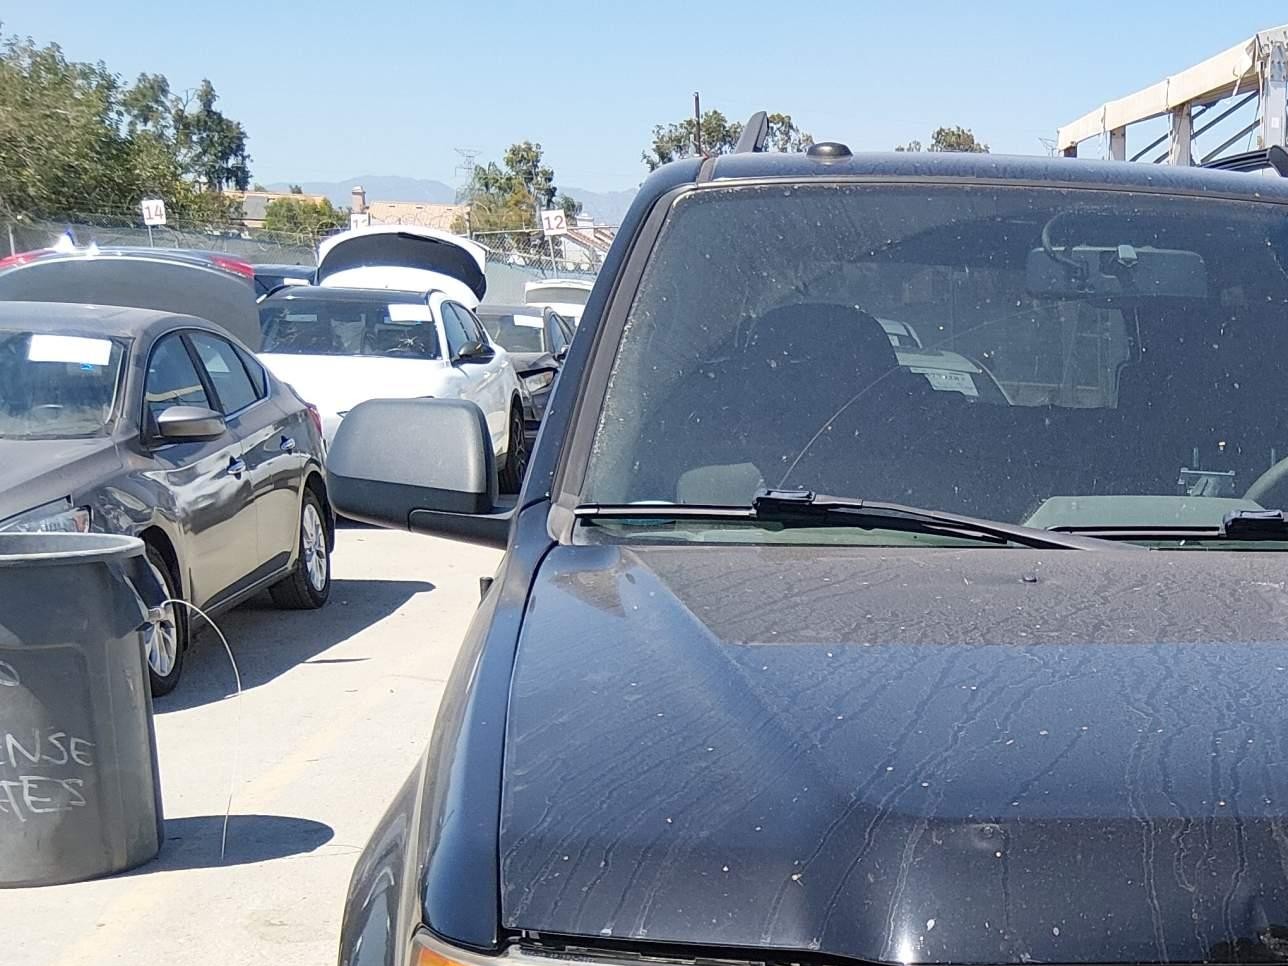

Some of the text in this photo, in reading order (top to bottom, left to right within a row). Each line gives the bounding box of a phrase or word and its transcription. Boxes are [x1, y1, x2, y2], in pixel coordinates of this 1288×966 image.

[144, 205, 164, 220] 14
[544, 215, 565, 231] 12
[0, 728, 96, 768] NSE
